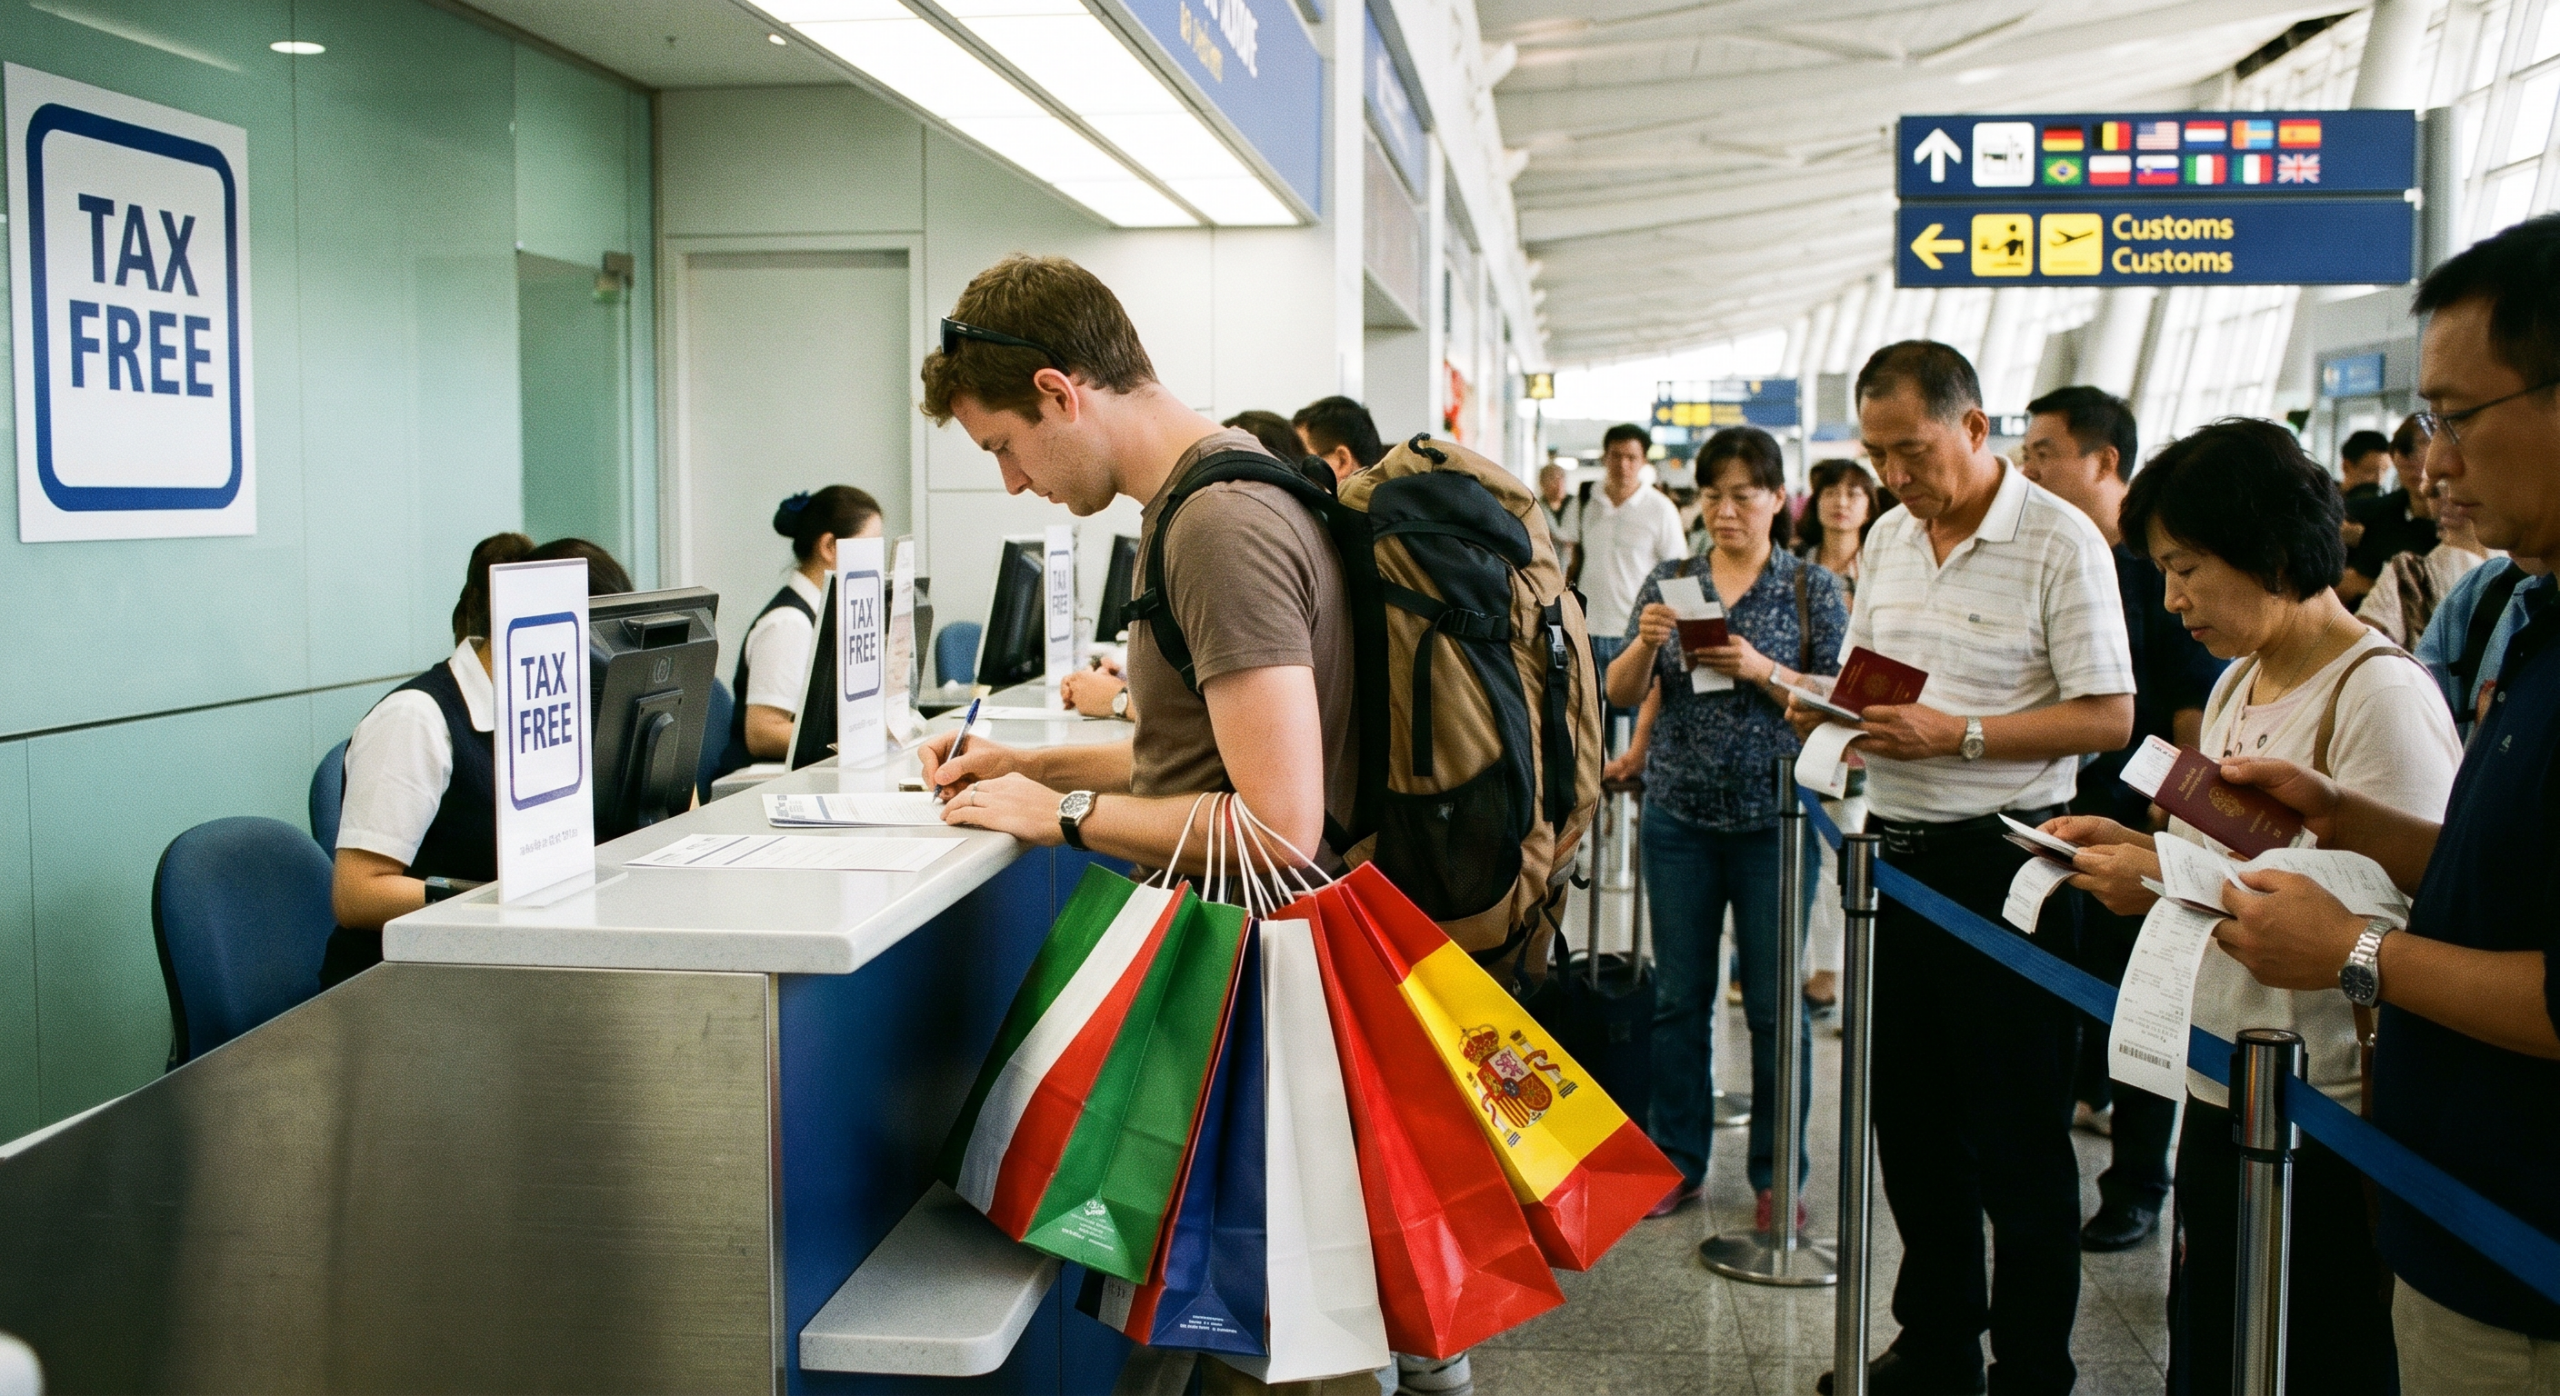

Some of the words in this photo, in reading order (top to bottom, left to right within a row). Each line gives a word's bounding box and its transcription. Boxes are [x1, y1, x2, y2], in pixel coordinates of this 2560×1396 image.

[78, 193, 199, 297] TAX
[2112, 213, 2234, 240] Customs
[2112, 246, 2233, 273] Customs
[69, 299, 214, 397] FREE
[850, 597, 874, 629] TAX
[849, 632, 876, 665] FREE
[520, 651, 567, 700] TAX
[520, 702, 572, 754] FREE
